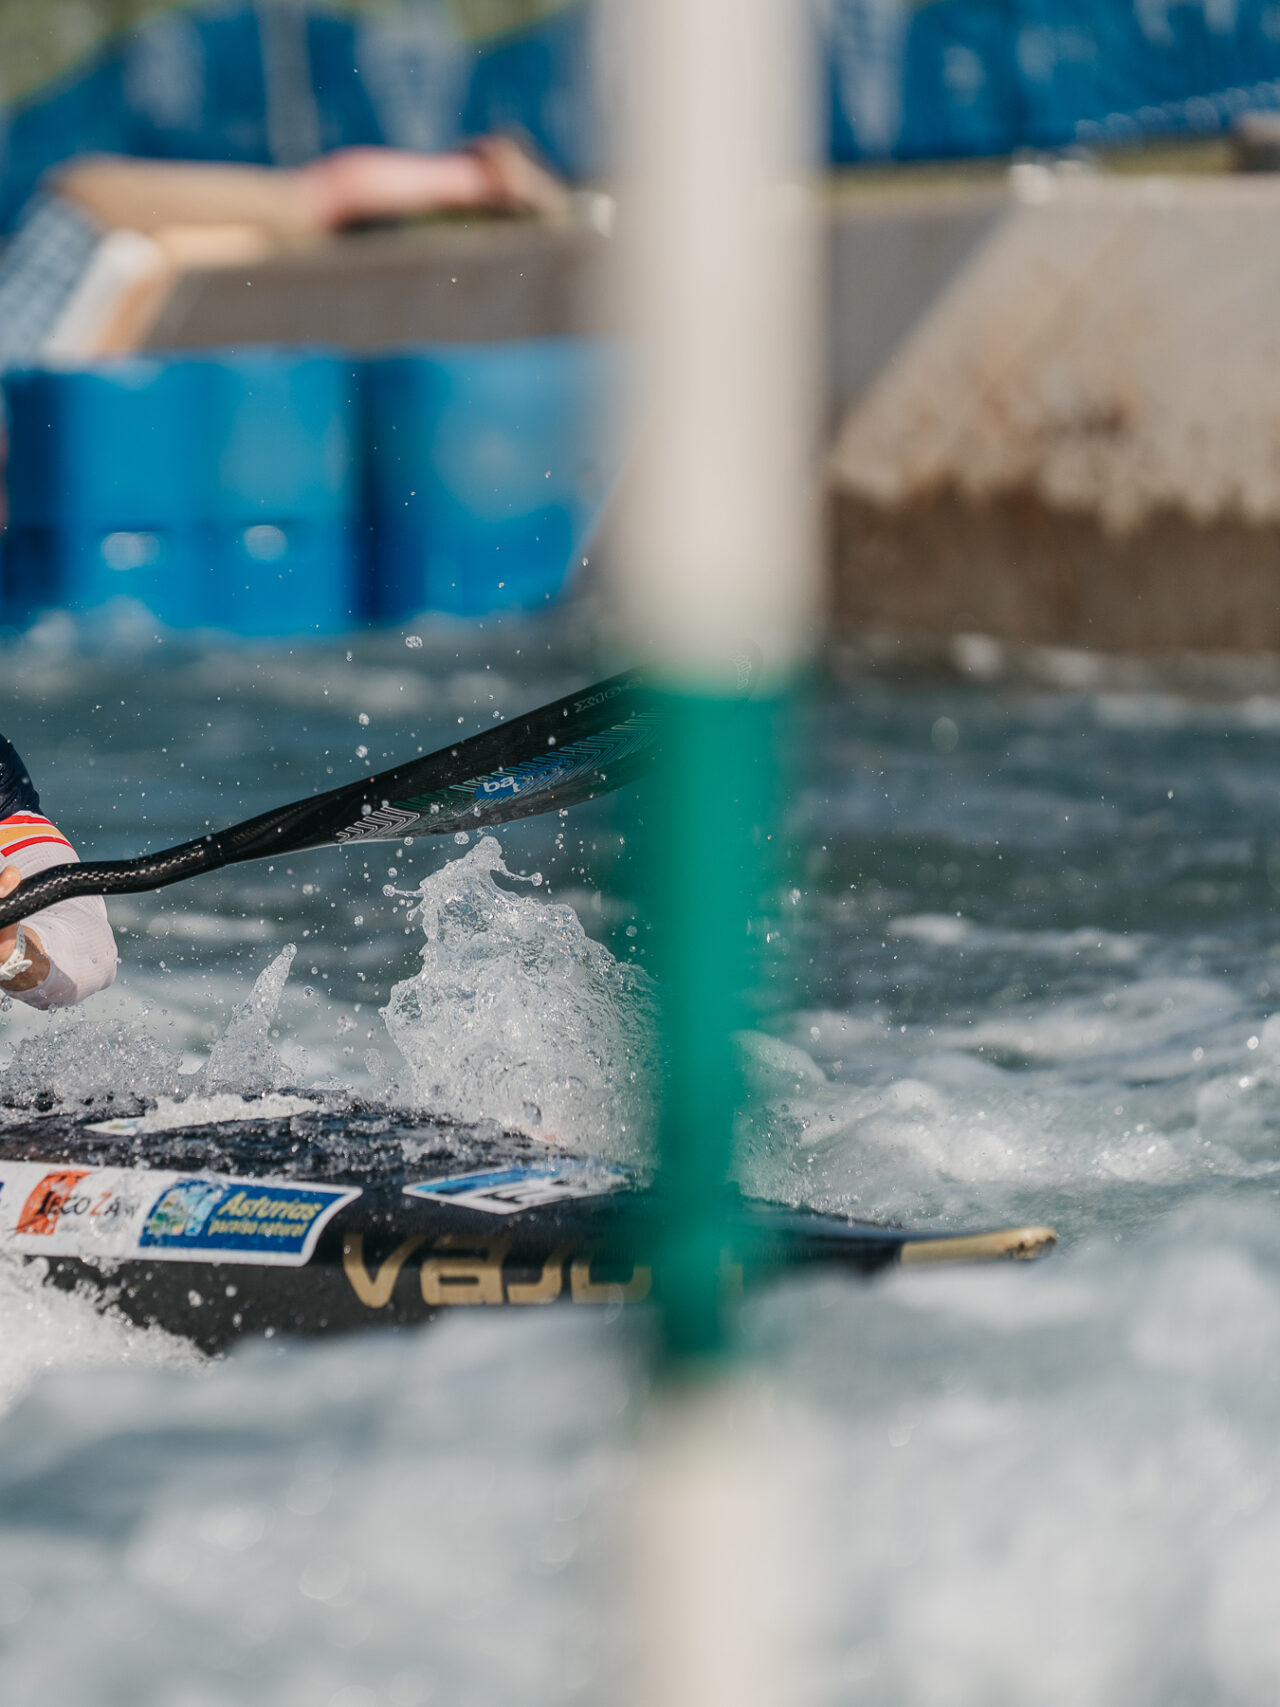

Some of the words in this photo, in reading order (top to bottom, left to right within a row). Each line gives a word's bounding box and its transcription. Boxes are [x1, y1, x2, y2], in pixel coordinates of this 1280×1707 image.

[217, 1191, 322, 1221] Asturias
[208, 1218, 256, 1237] paraiso
[257, 1221, 308, 1237] natural
